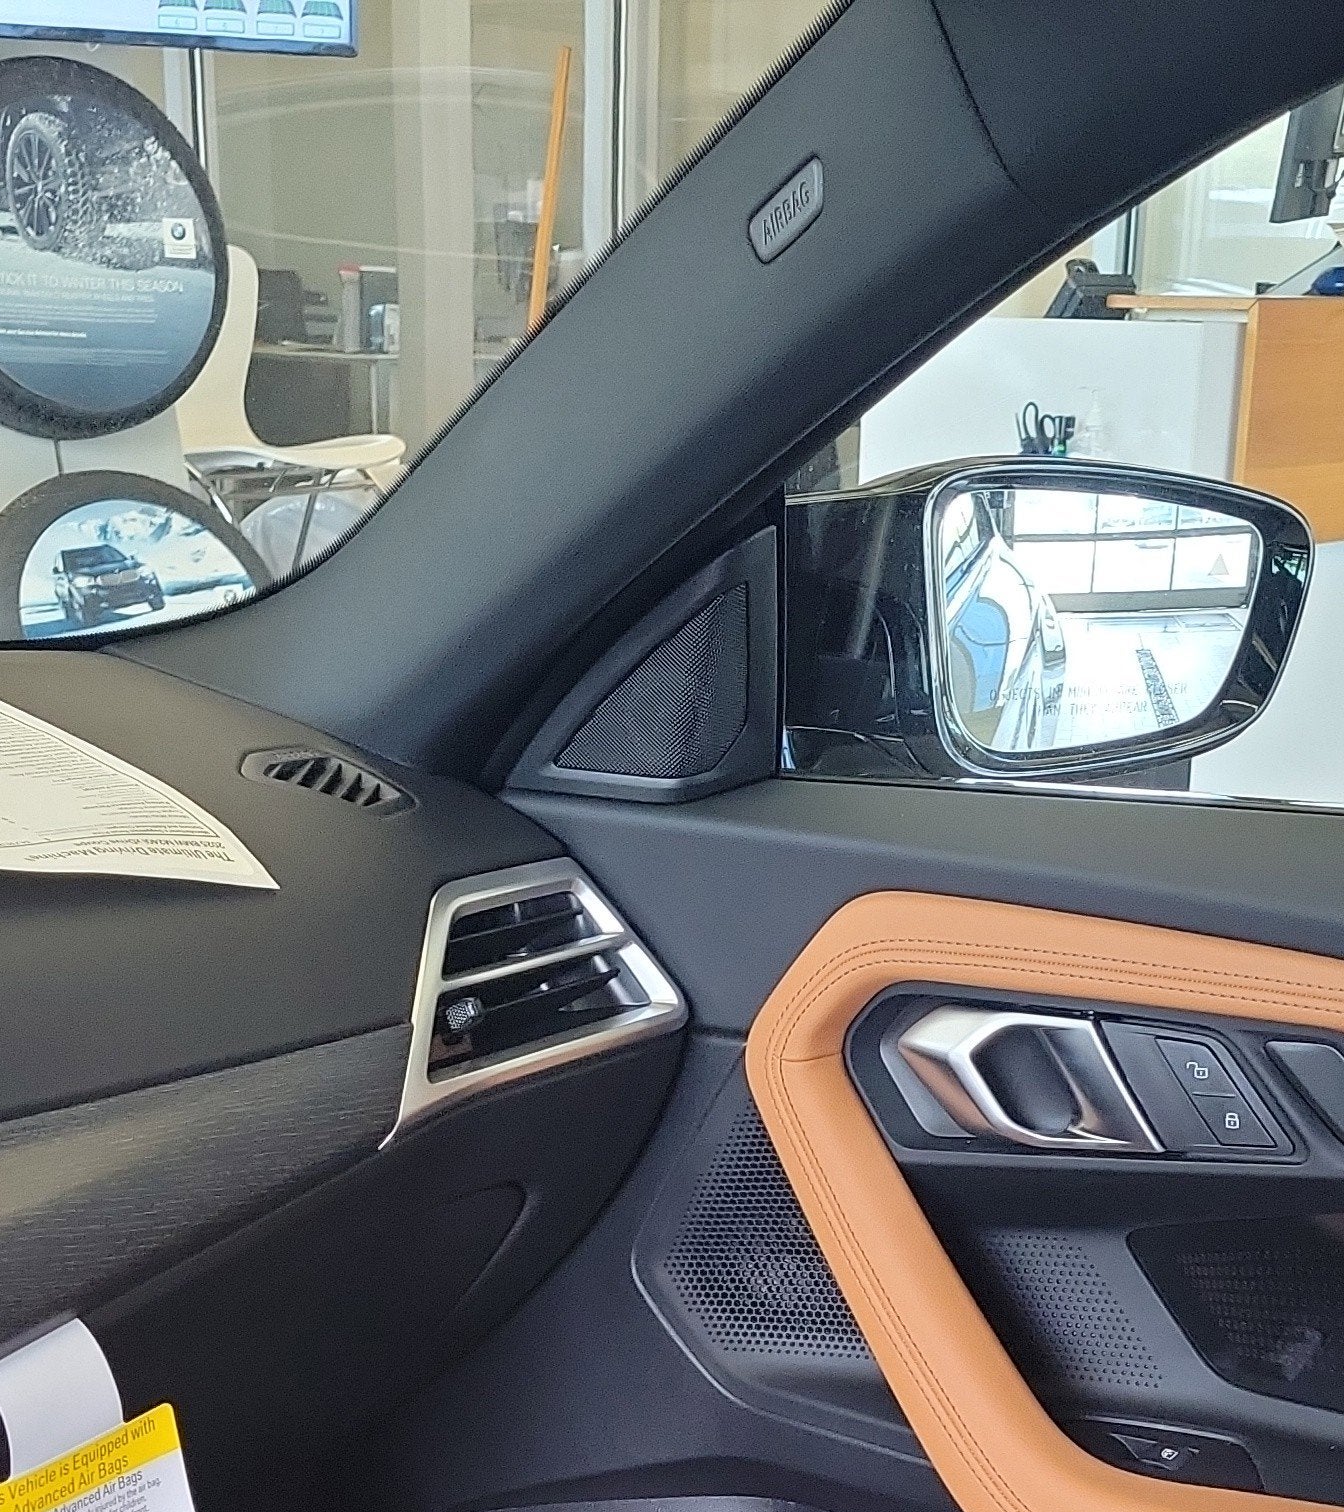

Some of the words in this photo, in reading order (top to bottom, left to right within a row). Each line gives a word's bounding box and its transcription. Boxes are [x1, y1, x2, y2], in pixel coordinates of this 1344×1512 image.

[762, 181, 811, 246] AIRBAG
[42, 275, 59, 288] TO
[137, 279, 184, 293] SEASON
[93, 845, 150, 857] Driving
[147, 846, 208, 861] Ultimate
[205, 850, 235, 863] The
[8, 1468, 56, 1500] Vehicle
[59, 1460, 69, 1478] is
[72, 1429, 129, 1471] Equipped
[130, 1416, 156, 1442] with
[78, 1469, 95, 1488] Air
[98, 1453, 129, 1480] Bags
[102, 1481, 117, 1498] Air
[117, 1470, 143, 1490] Bags
